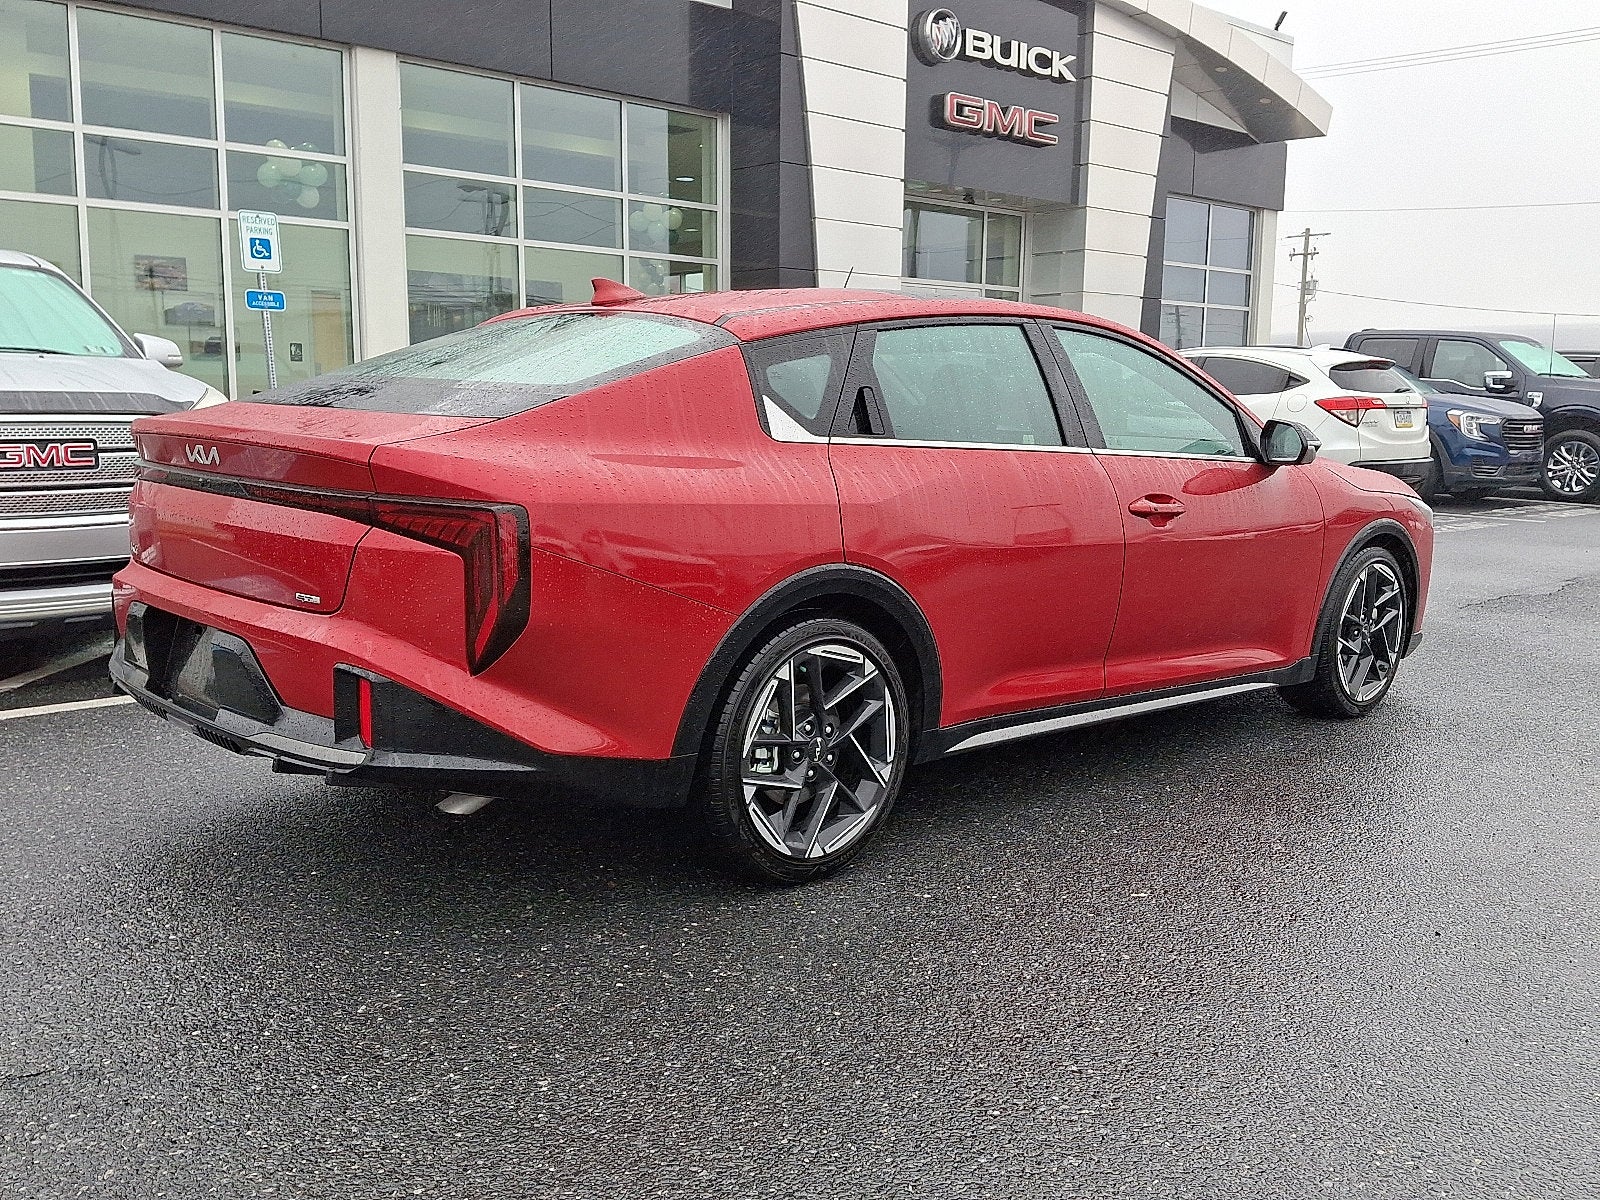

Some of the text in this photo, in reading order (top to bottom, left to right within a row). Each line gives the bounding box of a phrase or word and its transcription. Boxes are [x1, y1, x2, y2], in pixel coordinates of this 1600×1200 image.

[965, 28, 1077, 82] BUICK
[944, 91, 1059, 145] GMC
[242, 215, 276, 226] RESERVED
[246, 226, 273, 236] PARKING
[0, 443, 95, 468] GMC
[186, 443, 220, 466] KIA
